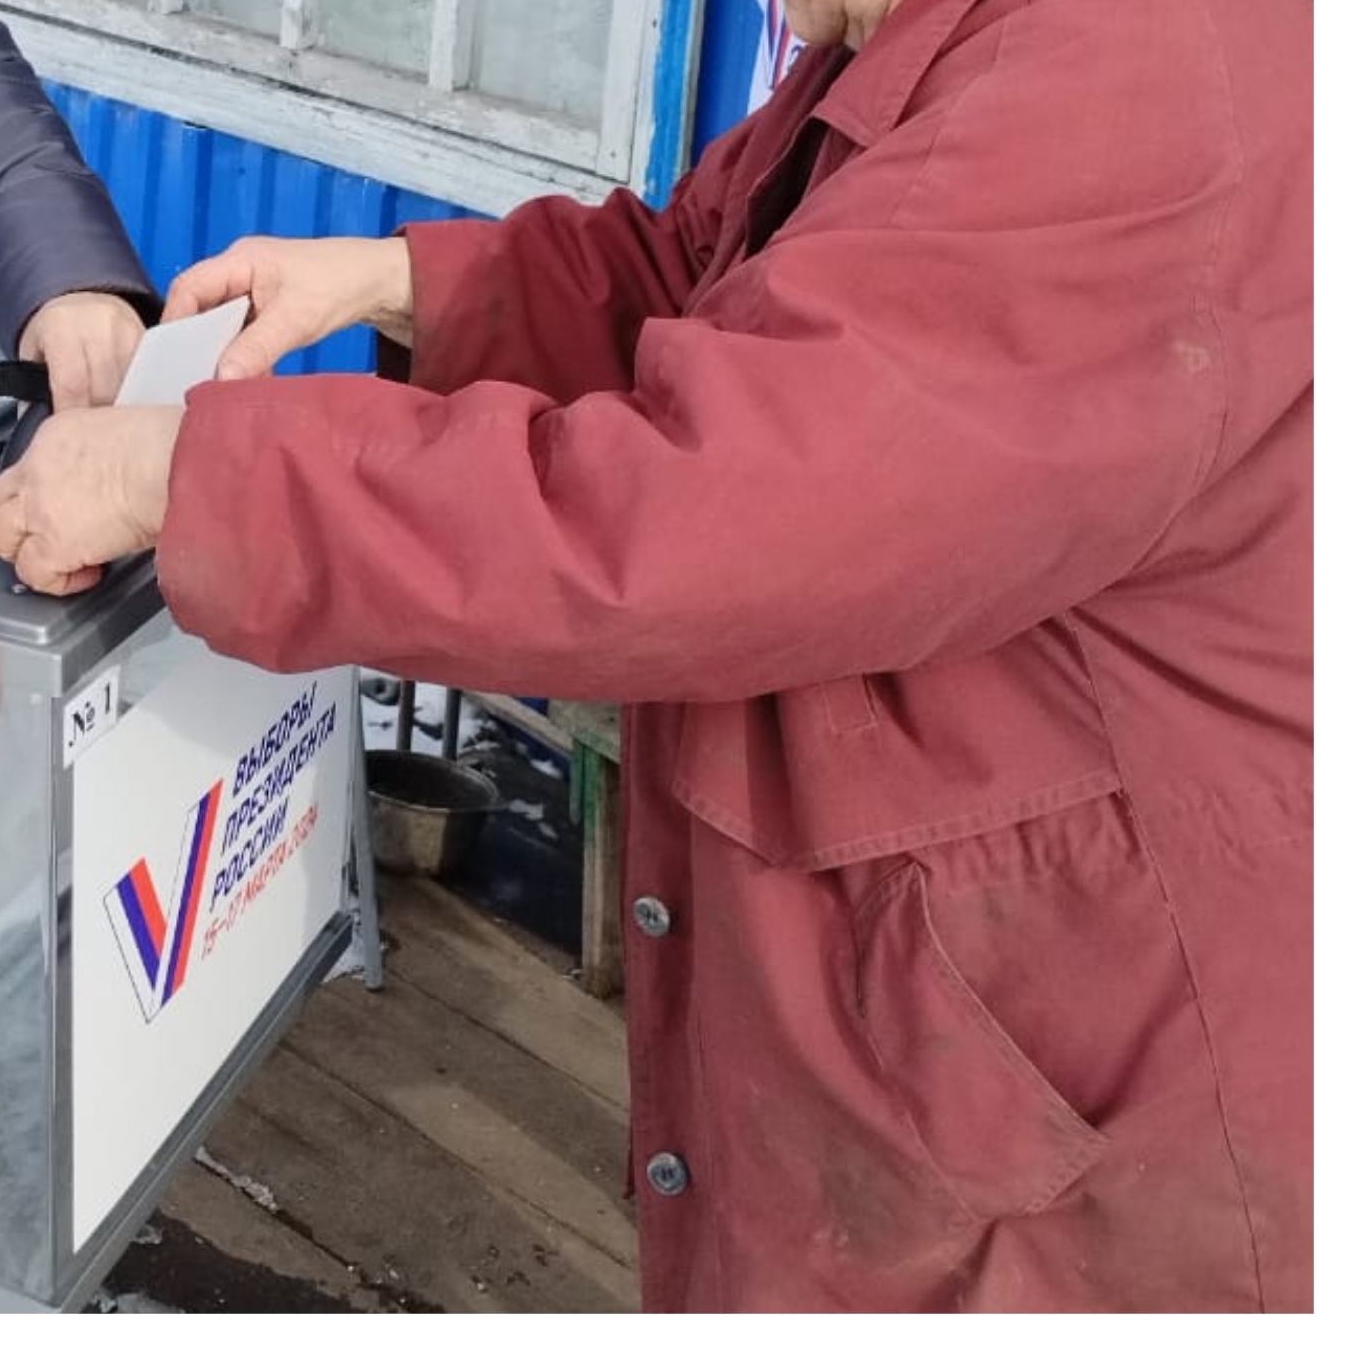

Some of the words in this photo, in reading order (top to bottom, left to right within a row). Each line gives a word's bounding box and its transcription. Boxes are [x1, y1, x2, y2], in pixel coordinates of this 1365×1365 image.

[68, 702, 96, 747] №
[103, 682, 112, 715] 1
[233, 680, 317, 798] ВЫБОРЫ
[221, 702, 336, 855] ПРЕЗИДЕНТА
[210, 797, 289, 913] РОССИИ
